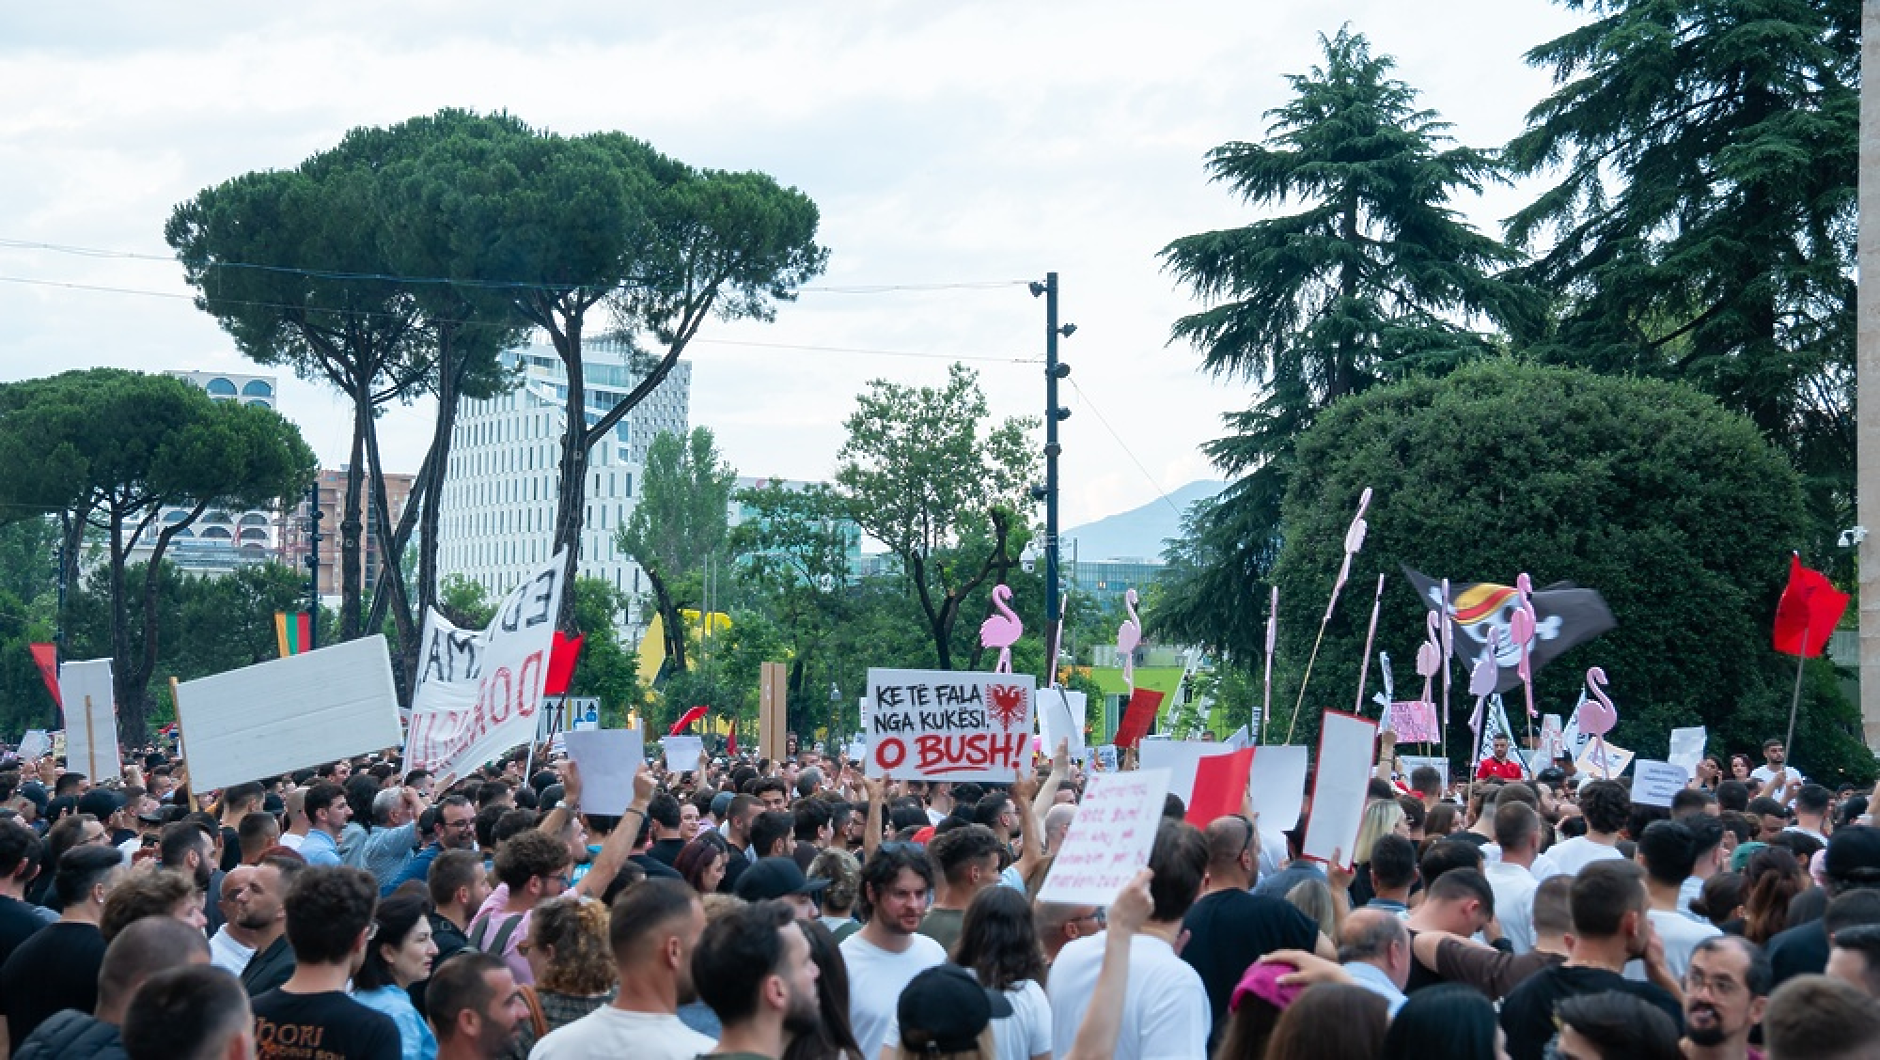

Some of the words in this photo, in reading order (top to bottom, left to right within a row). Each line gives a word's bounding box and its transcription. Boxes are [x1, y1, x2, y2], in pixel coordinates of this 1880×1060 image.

[876, 685, 904, 709] KE
[906, 684, 930, 706] TË
[934, 684, 983, 706] FALA
[874, 711, 914, 734] NGA
[875, 736, 906, 769] O
[914, 733, 1027, 769] BUSH!
